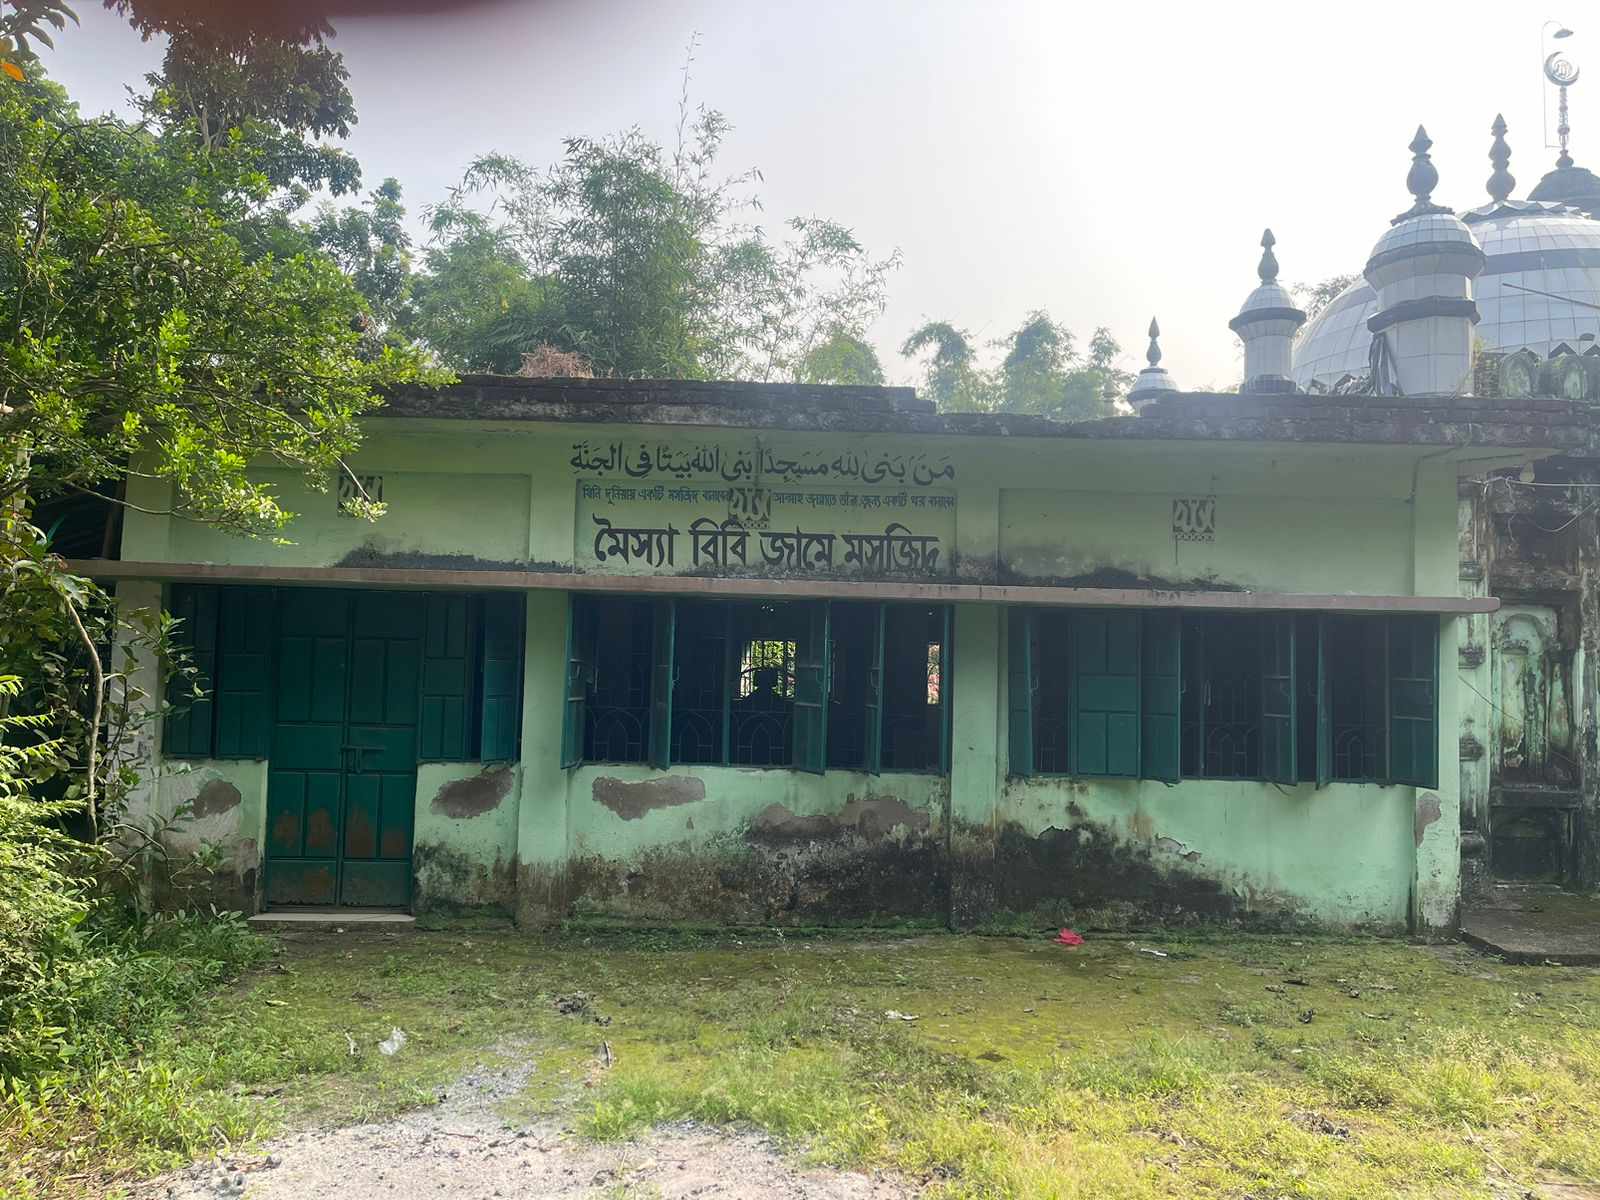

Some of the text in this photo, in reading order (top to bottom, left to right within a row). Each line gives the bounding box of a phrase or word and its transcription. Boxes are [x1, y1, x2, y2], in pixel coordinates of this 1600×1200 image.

[688, 517, 751, 567] বিবি
[758, 525, 837, 571] জামে
[841, 522, 940, 576] মসজিদ
